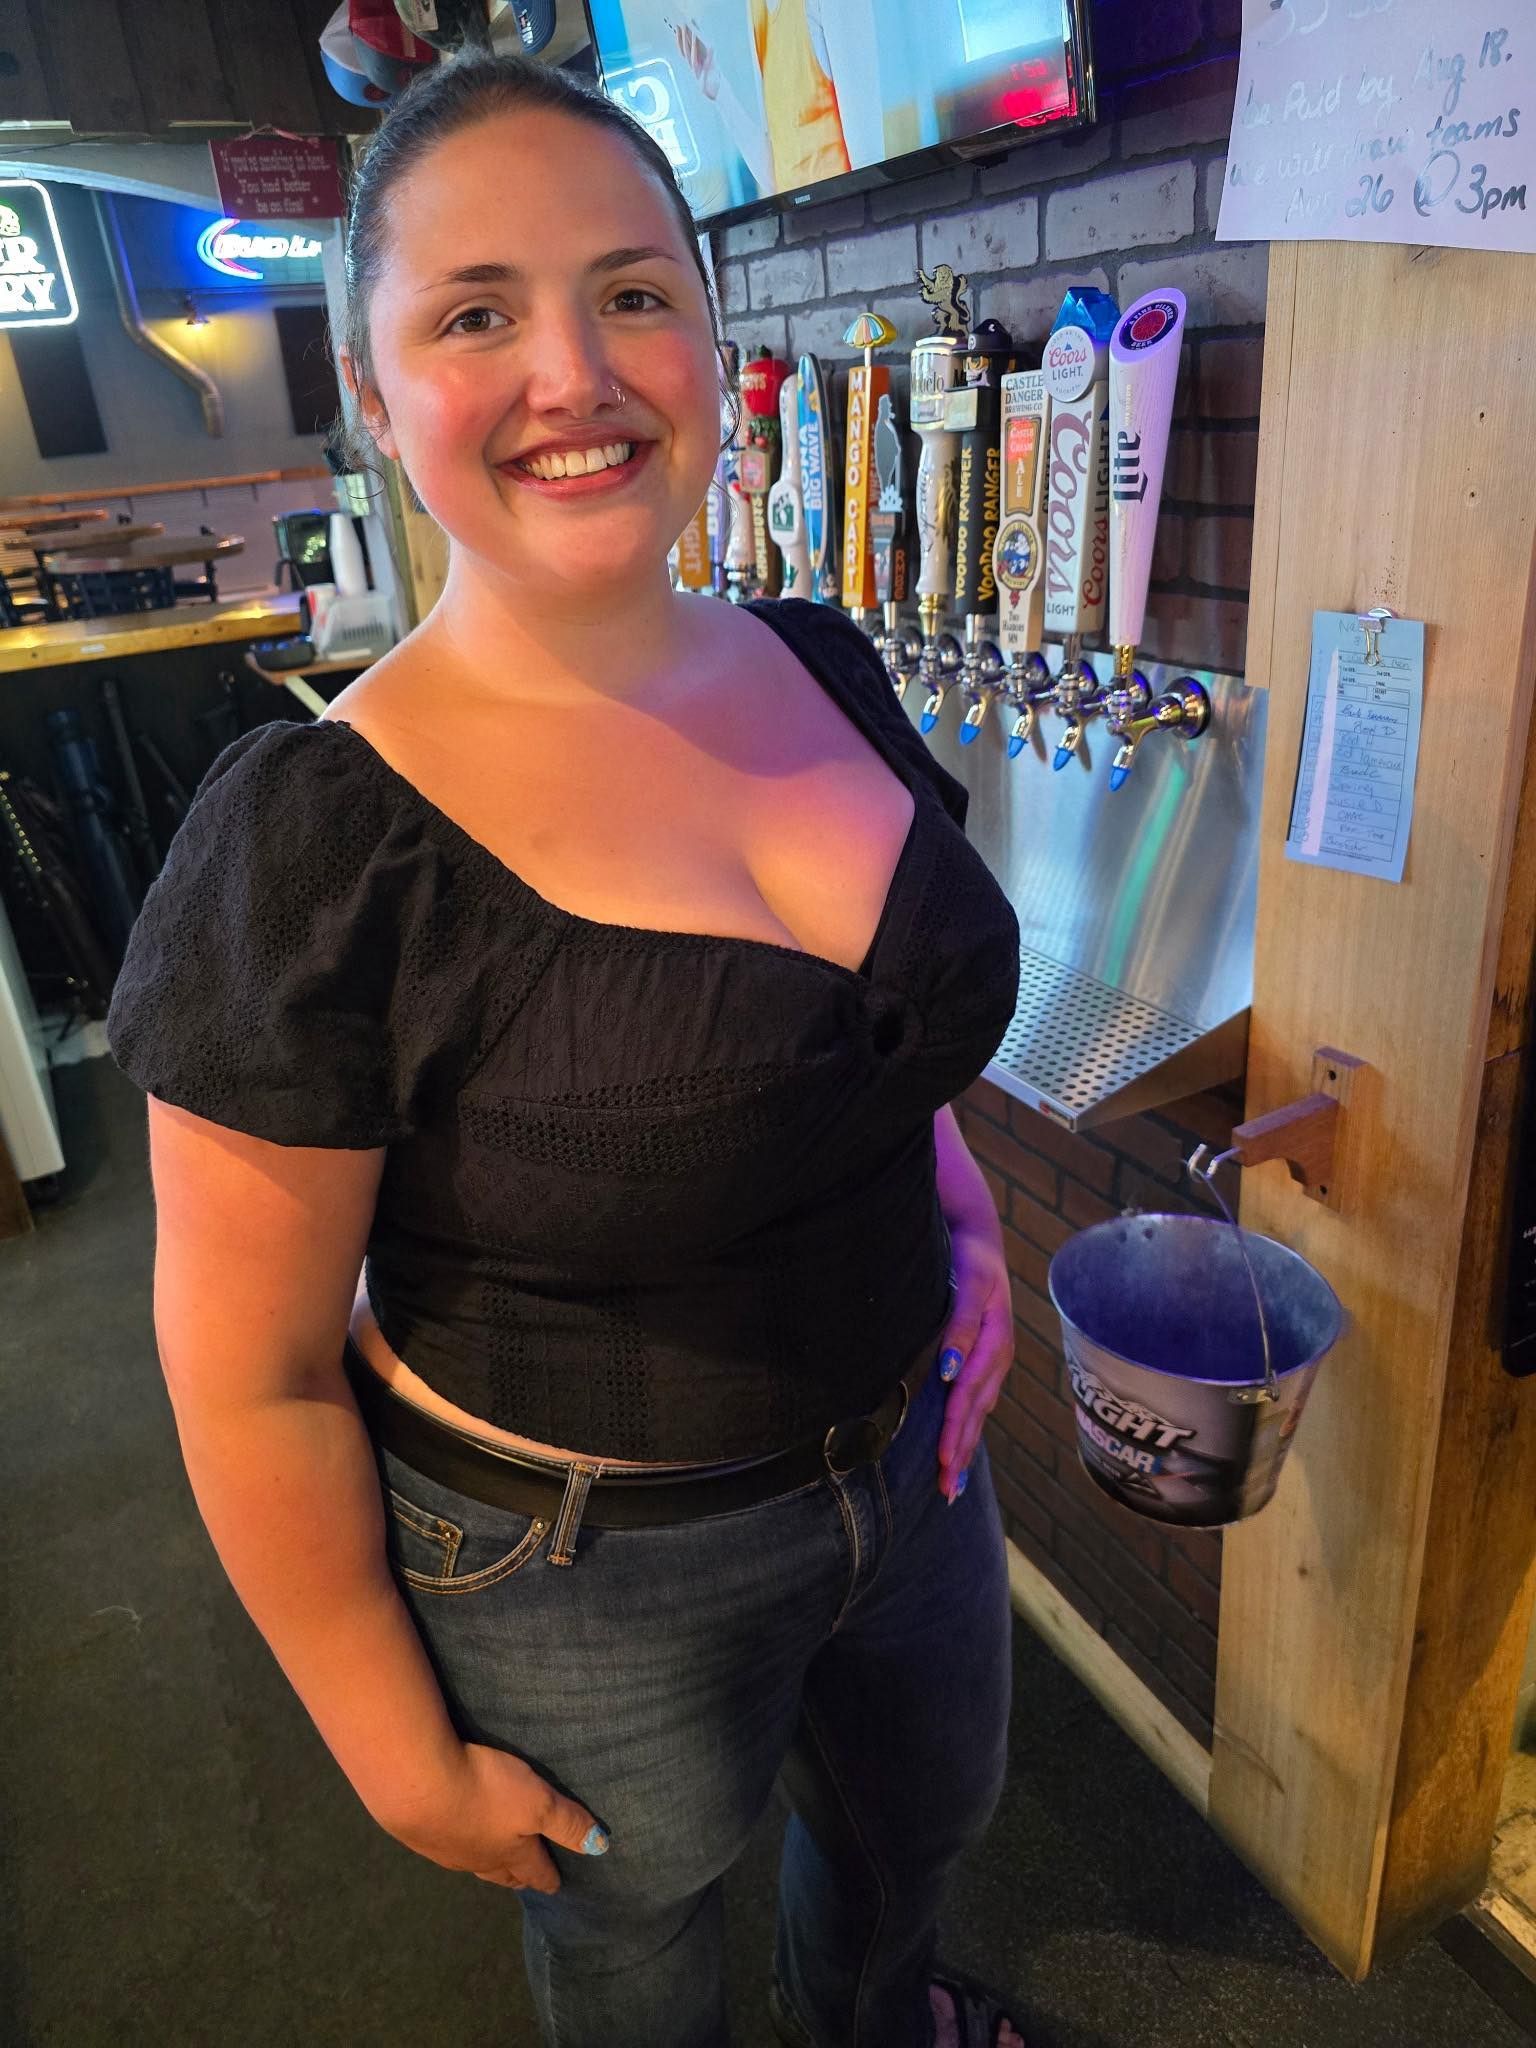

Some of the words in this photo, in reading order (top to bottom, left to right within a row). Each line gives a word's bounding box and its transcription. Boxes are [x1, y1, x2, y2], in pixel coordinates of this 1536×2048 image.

[1346, 173, 1394, 217] 26
[1005, 374, 1044, 391] CASTLE
[1049, 346, 1087, 368] Coors
[1052, 366, 1083, 381] LIGHT
[849, 370, 865, 487] MANGO
[1005, 388, 1043, 405] DANGER
[807, 422, 821, 477] WAVE
[1112, 430, 1149, 504] Lite
[958, 444, 973, 522] RANGER
[983, 447, 1000, 522] RANGER
[1047, 410, 1093, 599] Coors
[846, 497, 859, 589] CART
[955, 526, 968, 601] VOODOO
[1046, 602, 1076, 617] LIGHT
